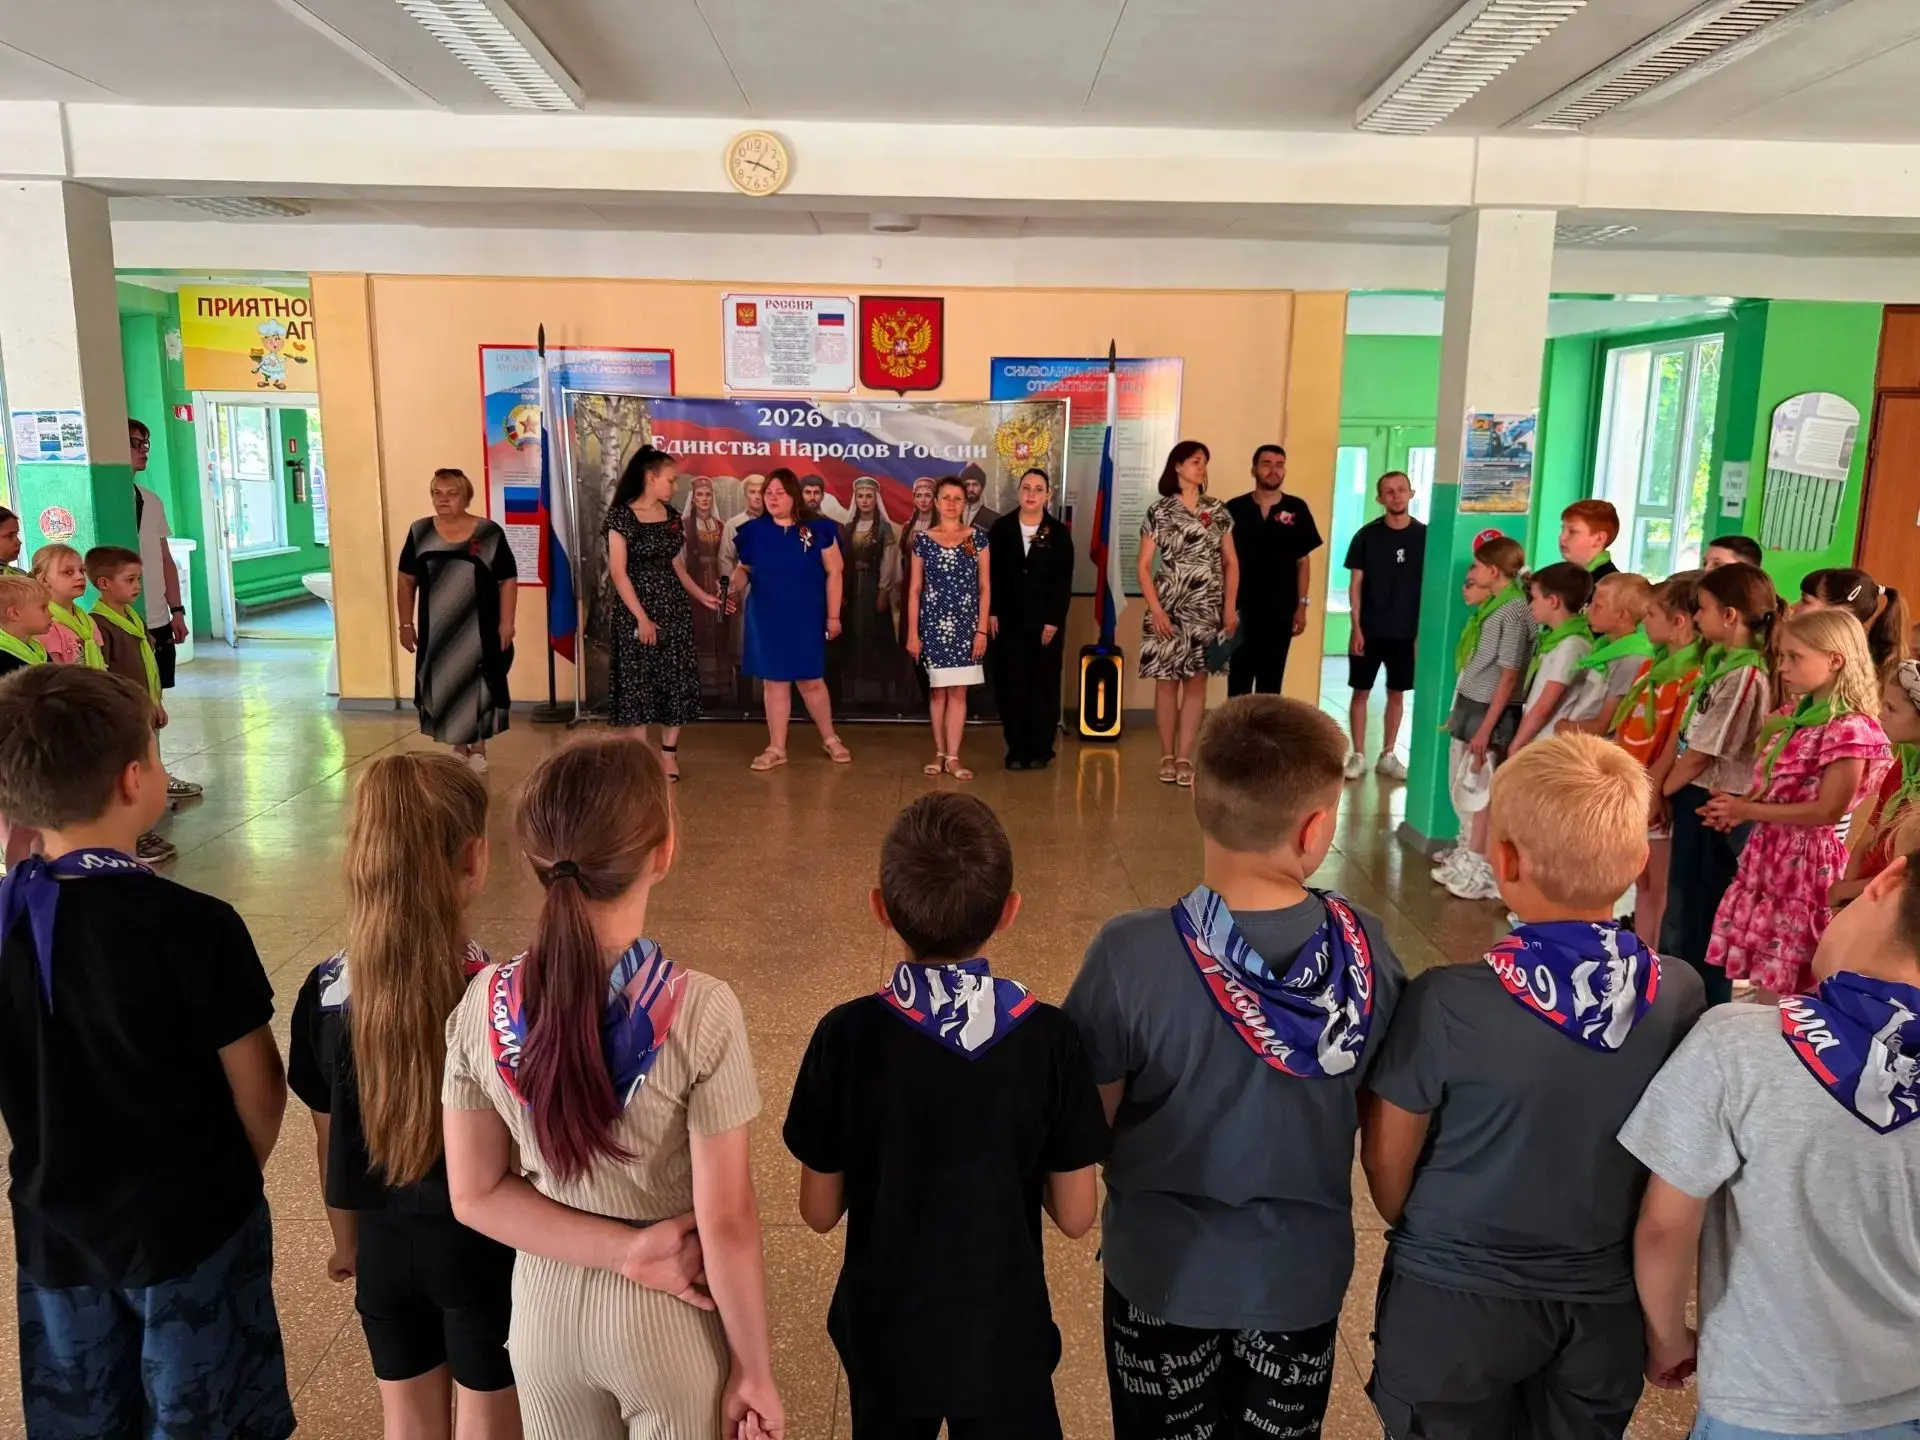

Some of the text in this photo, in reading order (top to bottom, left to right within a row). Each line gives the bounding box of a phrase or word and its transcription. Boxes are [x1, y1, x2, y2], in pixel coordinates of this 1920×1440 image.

[197, 297, 313, 317] ПРИЯТНО
[765, 299, 813, 310] РОССИЯ
[757, 407, 823, 427] 2026
[651, 435, 987, 462] Единства Народов России
[1165, 1402, 1205, 1425] Angels
[1266, 1397, 1306, 1413] Angels
[1243, 1407, 1281, 1436] Palm
